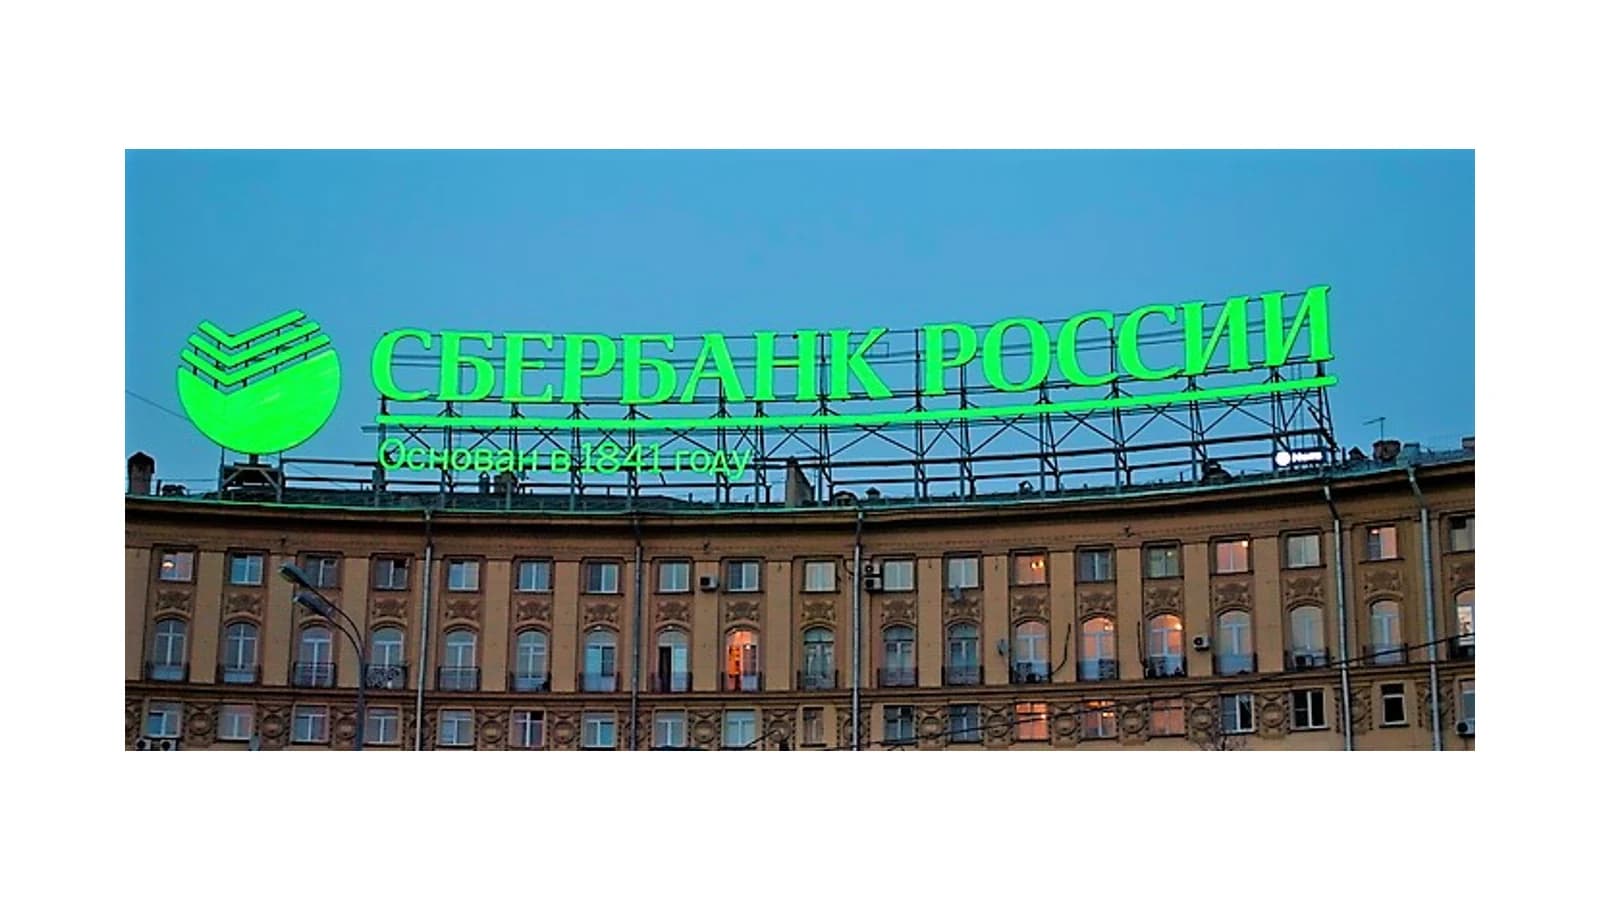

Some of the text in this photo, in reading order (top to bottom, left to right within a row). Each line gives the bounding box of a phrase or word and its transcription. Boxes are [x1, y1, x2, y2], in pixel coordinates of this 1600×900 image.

[371, 285, 1333, 404] СБЕРБАНК РОССИИ
[378, 438, 752, 481] Основан в 1841 году
